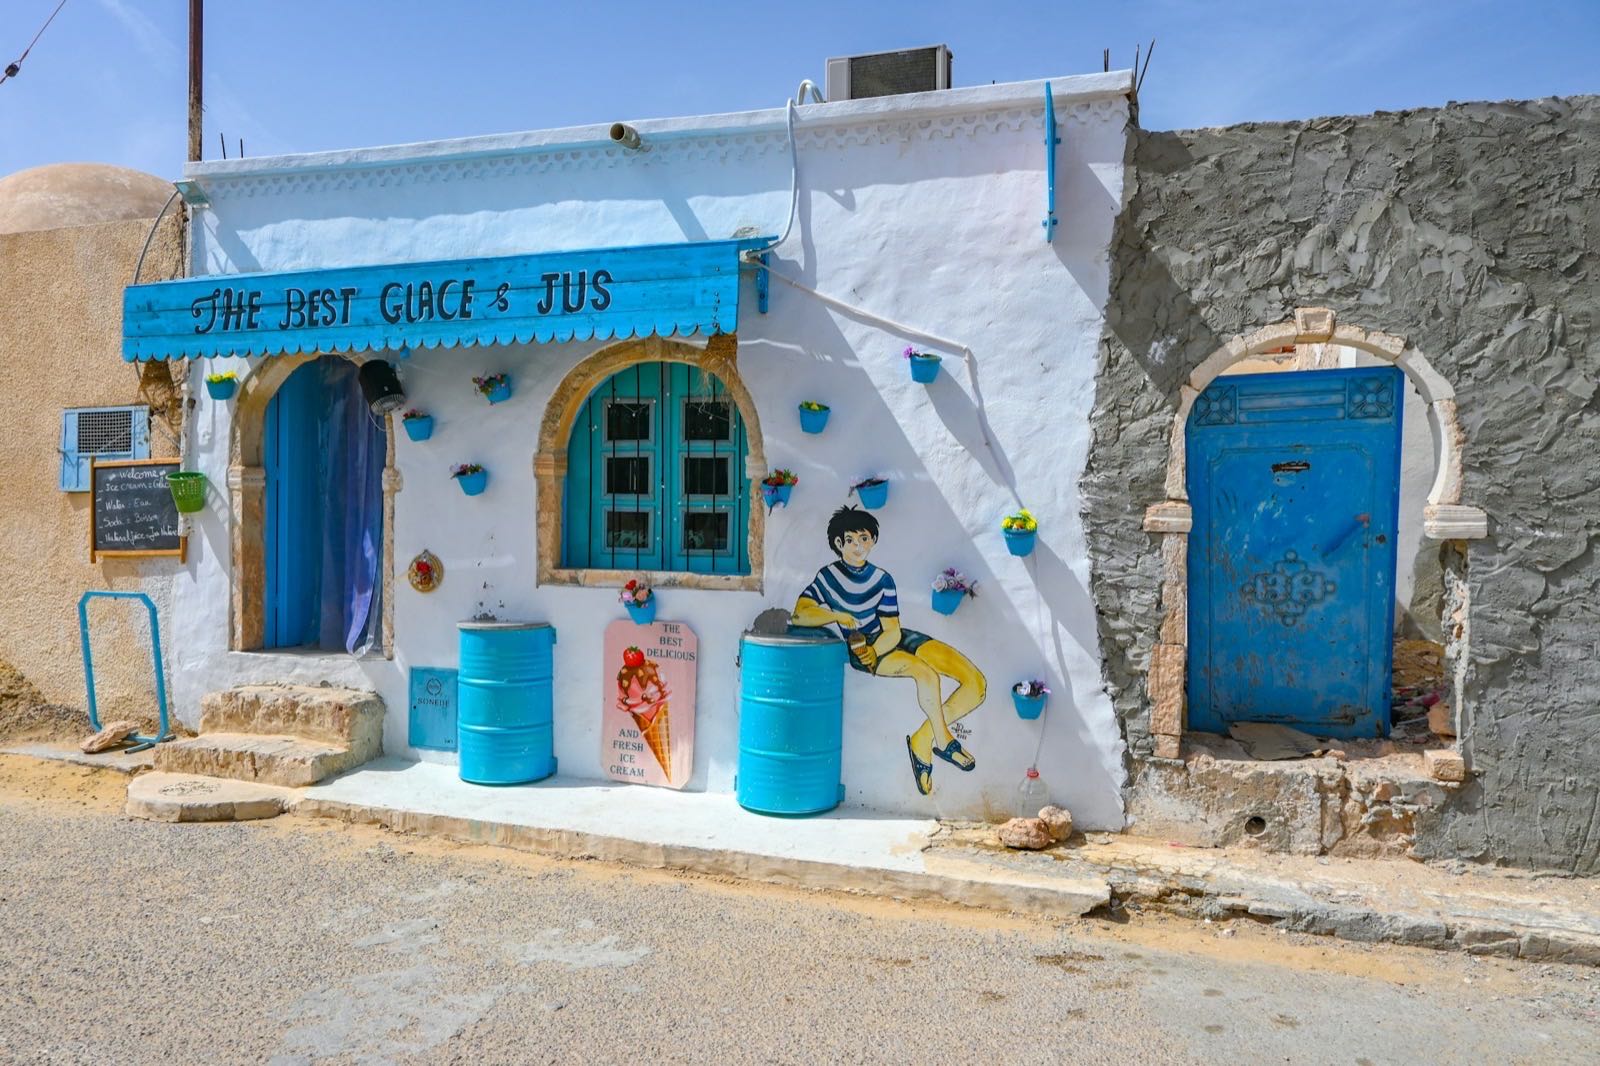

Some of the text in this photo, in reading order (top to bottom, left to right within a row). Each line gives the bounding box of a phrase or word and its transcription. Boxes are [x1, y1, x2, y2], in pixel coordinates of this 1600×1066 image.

[191, 287, 262, 334] THE
[279, 287, 357, 330] BEST
[379, 279, 475, 324] GLACE
[537, 269, 614, 315] JUS
[105, 499, 125, 511] Water
[103, 516, 123, 528] Soda
[663, 623, 681, 634] THE
[659, 636, 683, 647] BEST
[646, 647, 696, 661] DELICIOUS
[618, 728, 639, 739] AND
[612, 740, 644, 752] FRESH
[619, 754, 635, 764] ICE
[609, 764, 645, 777] CREAM
